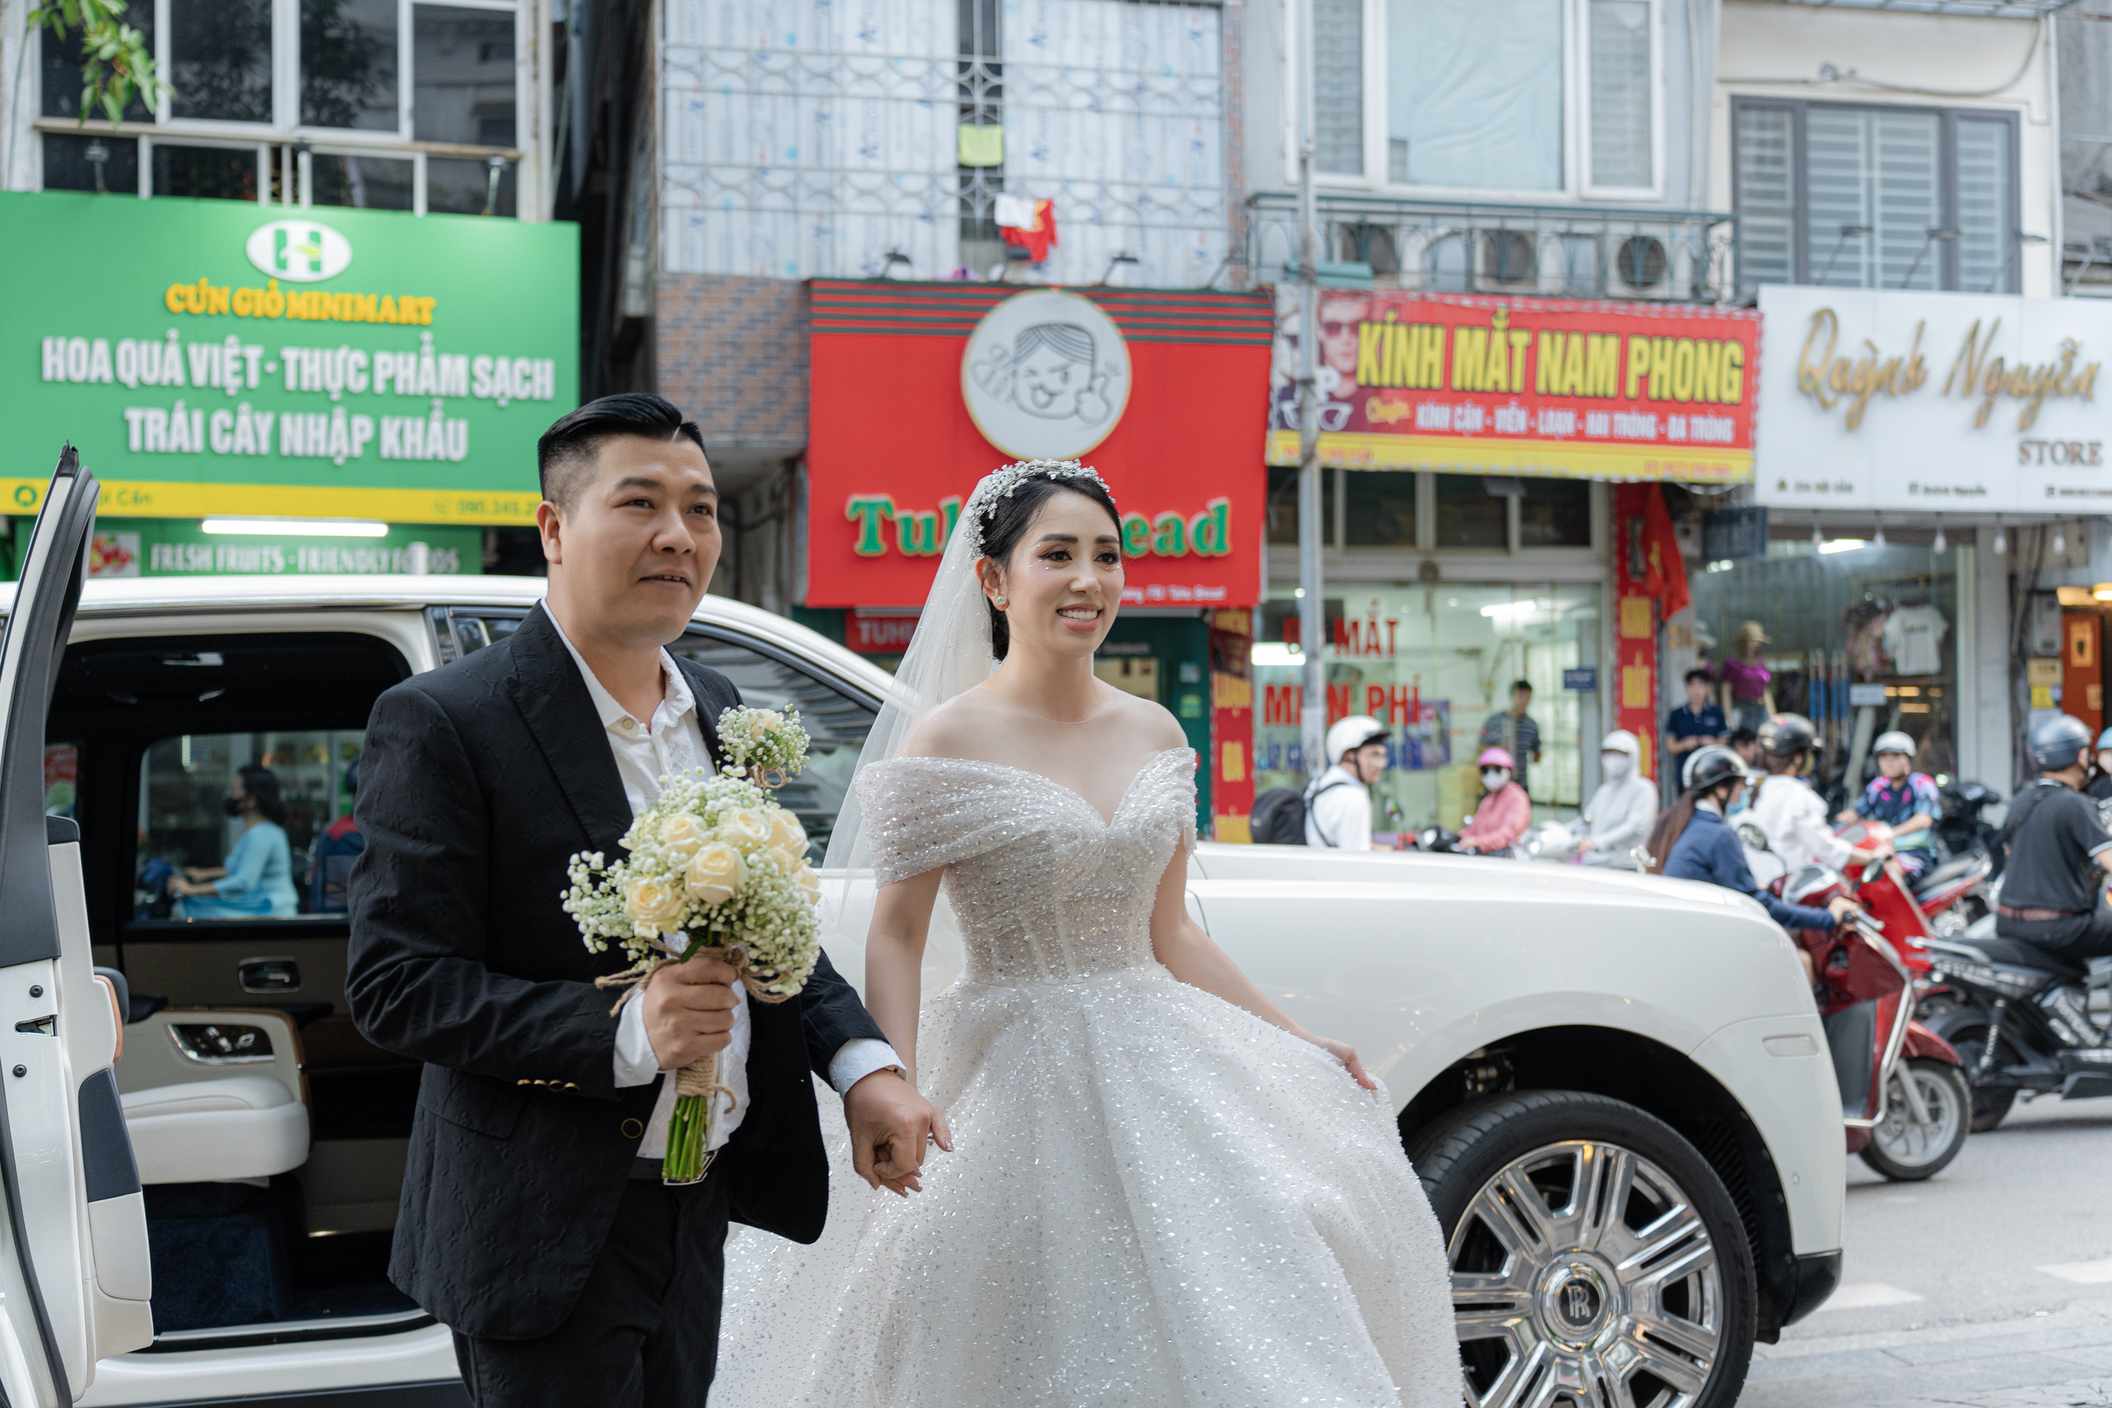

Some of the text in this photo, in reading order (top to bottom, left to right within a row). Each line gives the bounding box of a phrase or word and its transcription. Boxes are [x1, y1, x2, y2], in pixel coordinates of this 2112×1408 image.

[286, 291, 436, 325] MINIMART
[42, 336, 113, 384] HOA
[116, 328, 185, 389] QUẢ
[187, 335, 264, 396] VIỆT
[280, 344, 369, 401] THỰC
[373, 331, 469, 397] PHẨM
[472, 355, 555, 407] SẠCH
[1356, 307, 1744, 405] KÍNH MẮT NAM PHONG
[124, 399, 468, 465] TRÁI CÂY NHẬP KHẨU
[2018, 440, 2103, 466] STORE
[151, 543, 212, 572] FRESH
[216, 544, 284, 573] FRUITS
[298, 547, 390, 575] FRIENDLY
[1264, 681, 1350, 727] MIN
